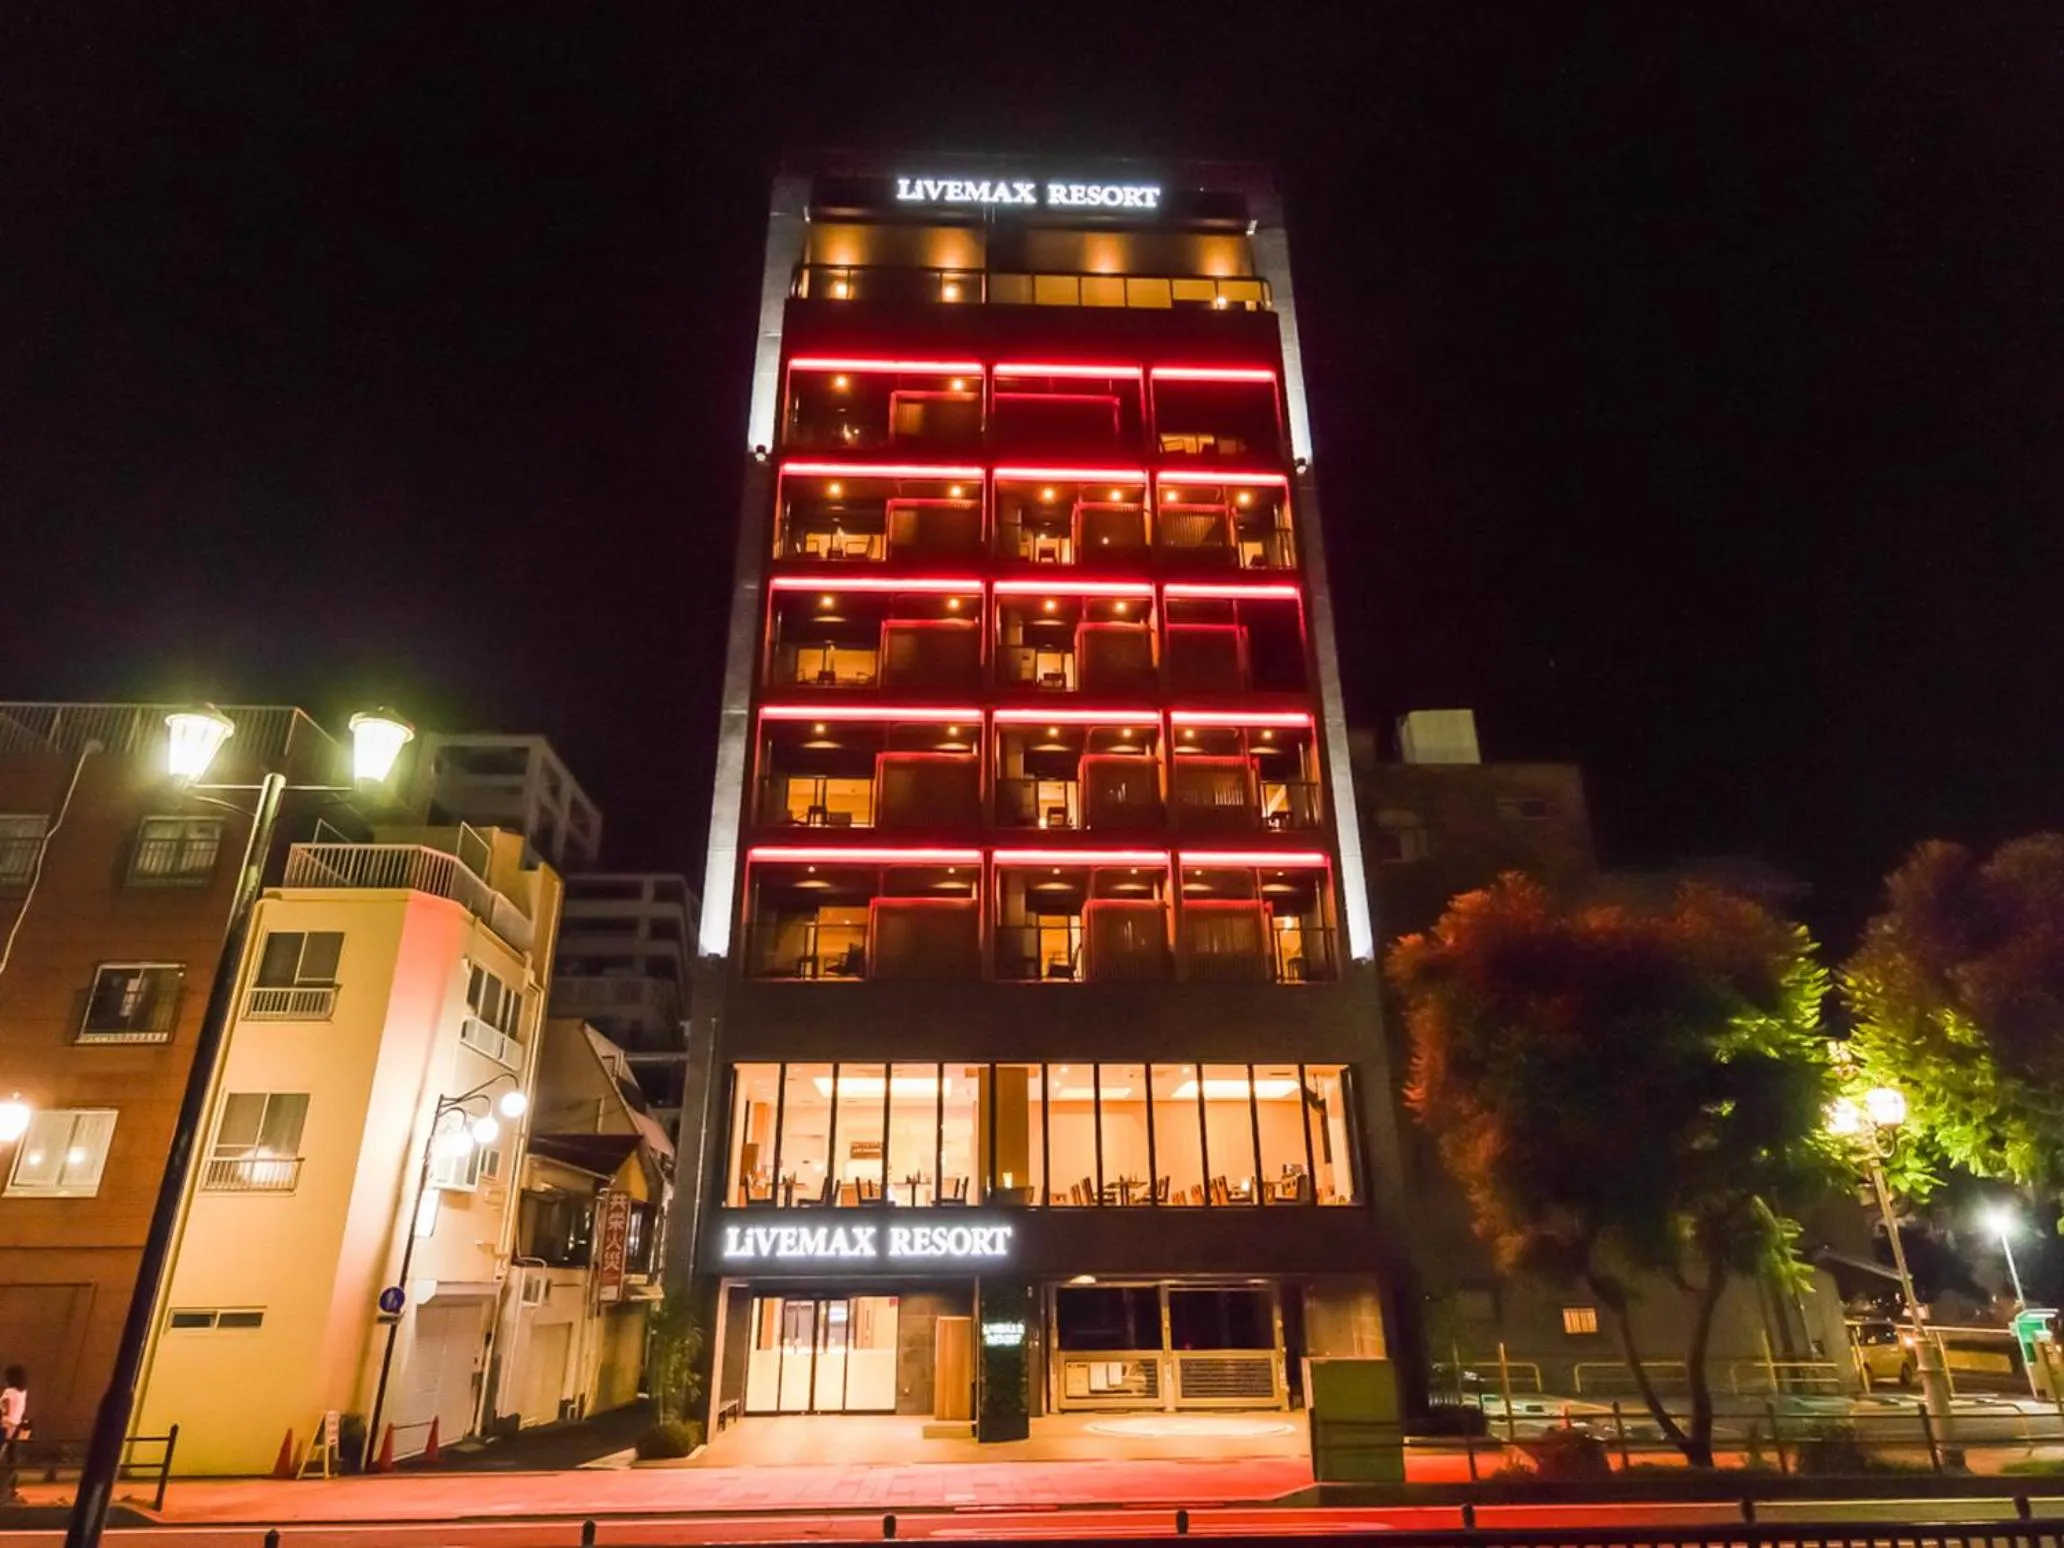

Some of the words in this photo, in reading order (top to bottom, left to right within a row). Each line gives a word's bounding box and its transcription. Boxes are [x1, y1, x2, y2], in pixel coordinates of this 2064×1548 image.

[897, 179, 1036, 204] LiVEMAX
[1047, 183, 1160, 208] RESORT
[724, 1226, 876, 1256] LiVEMAX
[889, 1225, 1012, 1256] RESORT
